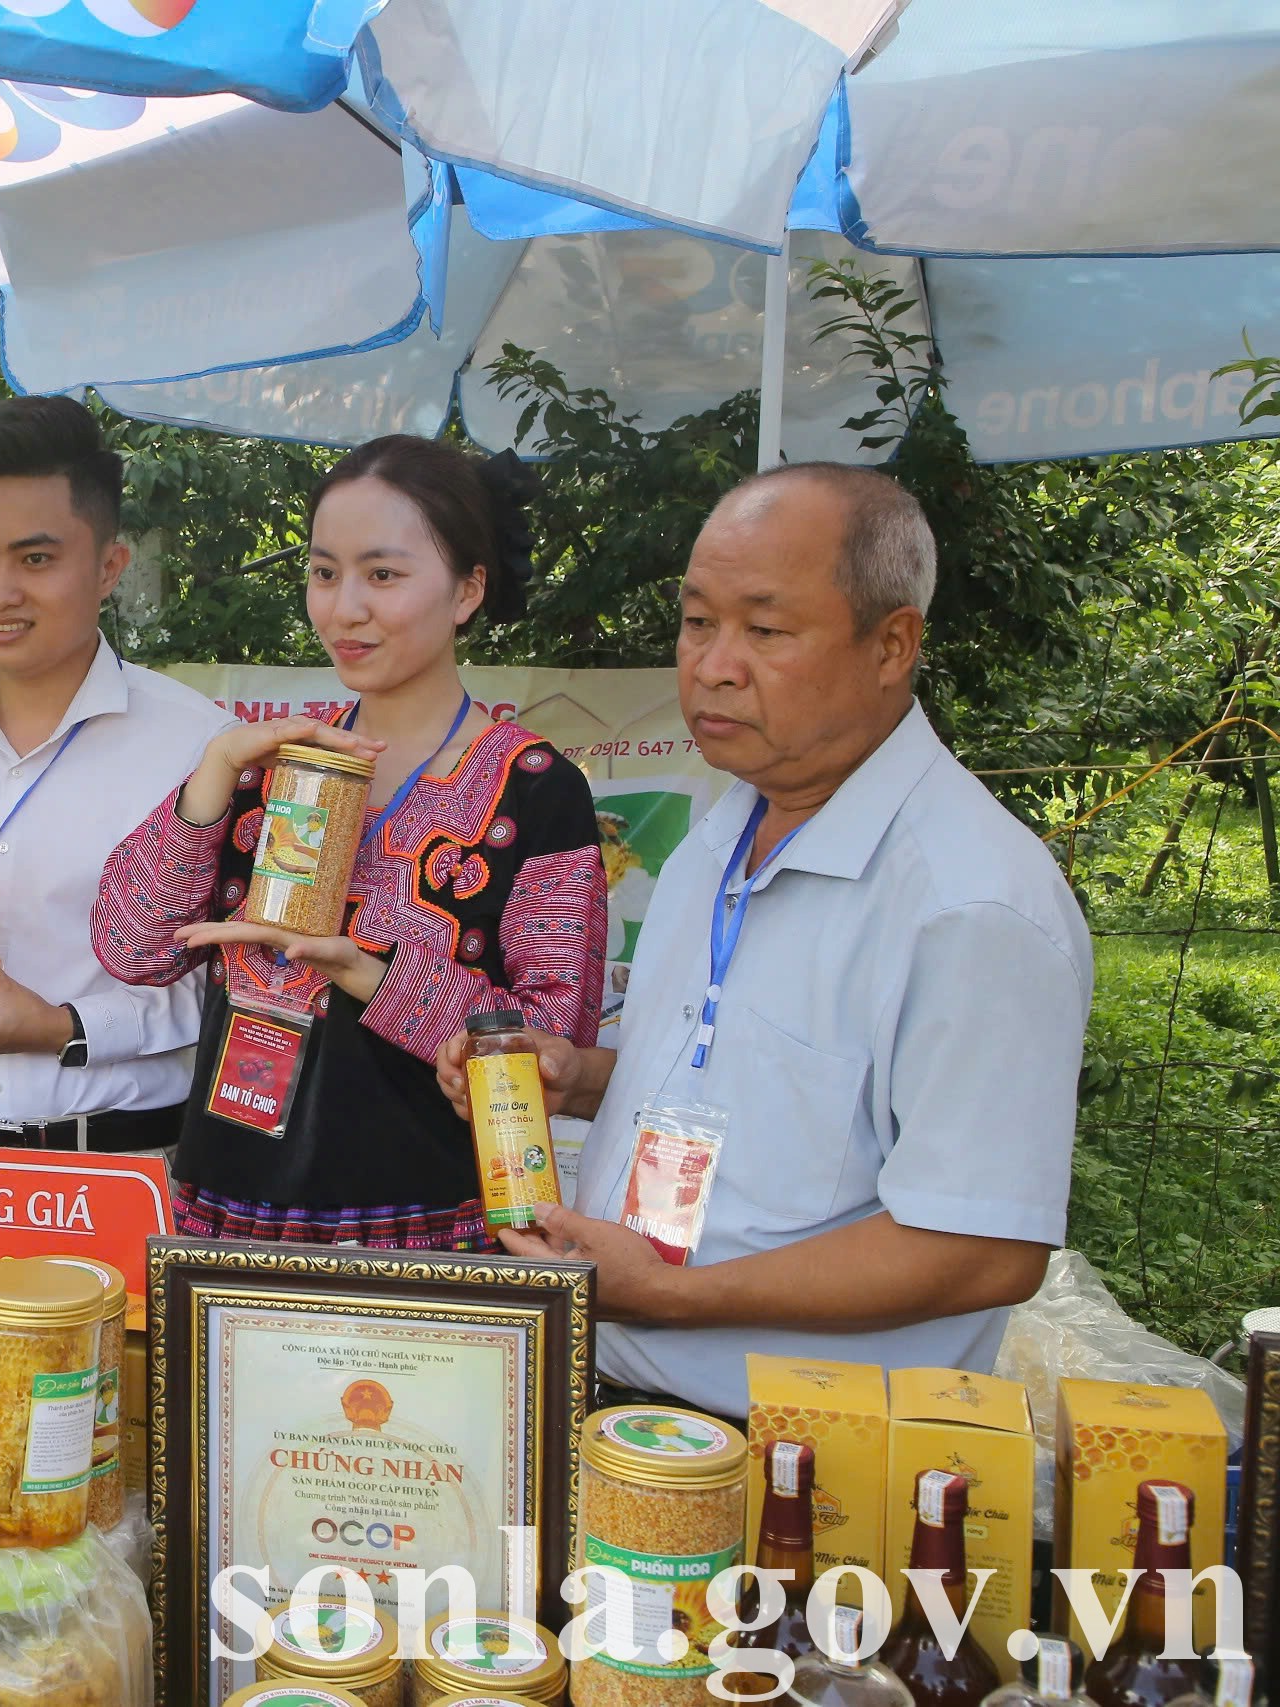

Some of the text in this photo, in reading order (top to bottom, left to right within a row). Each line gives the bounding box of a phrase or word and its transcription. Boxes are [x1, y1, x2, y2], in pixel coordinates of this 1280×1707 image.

[590, 740, 630, 756] 0912
[638, 741, 674, 756] 647
[275, 804, 292, 815] HOA
[220, 1082, 277, 1115] BAN TỔ CHỨC
[511, 1101, 529, 1112] Ong
[488, 1116, 534, 1128] Mộc Châu
[27, 1184, 95, 1230] GIÁ
[282, 1344, 307, 1353] CỘNG
[309, 1346, 327, 1355] HÒA
[343, 1348, 360, 1357] HỘI
[381, 1351, 409, 1361] NGHĨA
[411, 1353, 432, 1363] VIỆT
[433, 1355, 454, 1364] NAM
[289, 1433, 310, 1442] BAN
[311, 1435, 341, 1445] NHÂN
[342, 1436, 365, 1446] DÂN
[365, 1440, 401, 1451] HUYỆN
[402, 1443, 426, 1453] MỘC
[428, 1444, 457, 1454] CHÂU
[270, 1447, 464, 1487] CHỨNG NHẬN
[292, 1477, 440, 1498] SẢN PHẨM OCOP CẤP HUYỆN
[294, 1490, 327, 1502] Chương
[381, 1499, 397, 1507] một
[399, 1500, 413, 1508] sản
[325, 1504, 347, 1514] Công
[348, 1505, 370, 1516] nhận
[371, 1507, 383, 1517] lại
[311, 1517, 416, 1551] OCOP
[360, 1558, 384, 1566] PRODUCT
[393, 1561, 418, 1569] VIETNAM
[631, 1559, 710, 1576] PHẤN HOA
[815, 1552, 870, 1567] Mộc Châu
